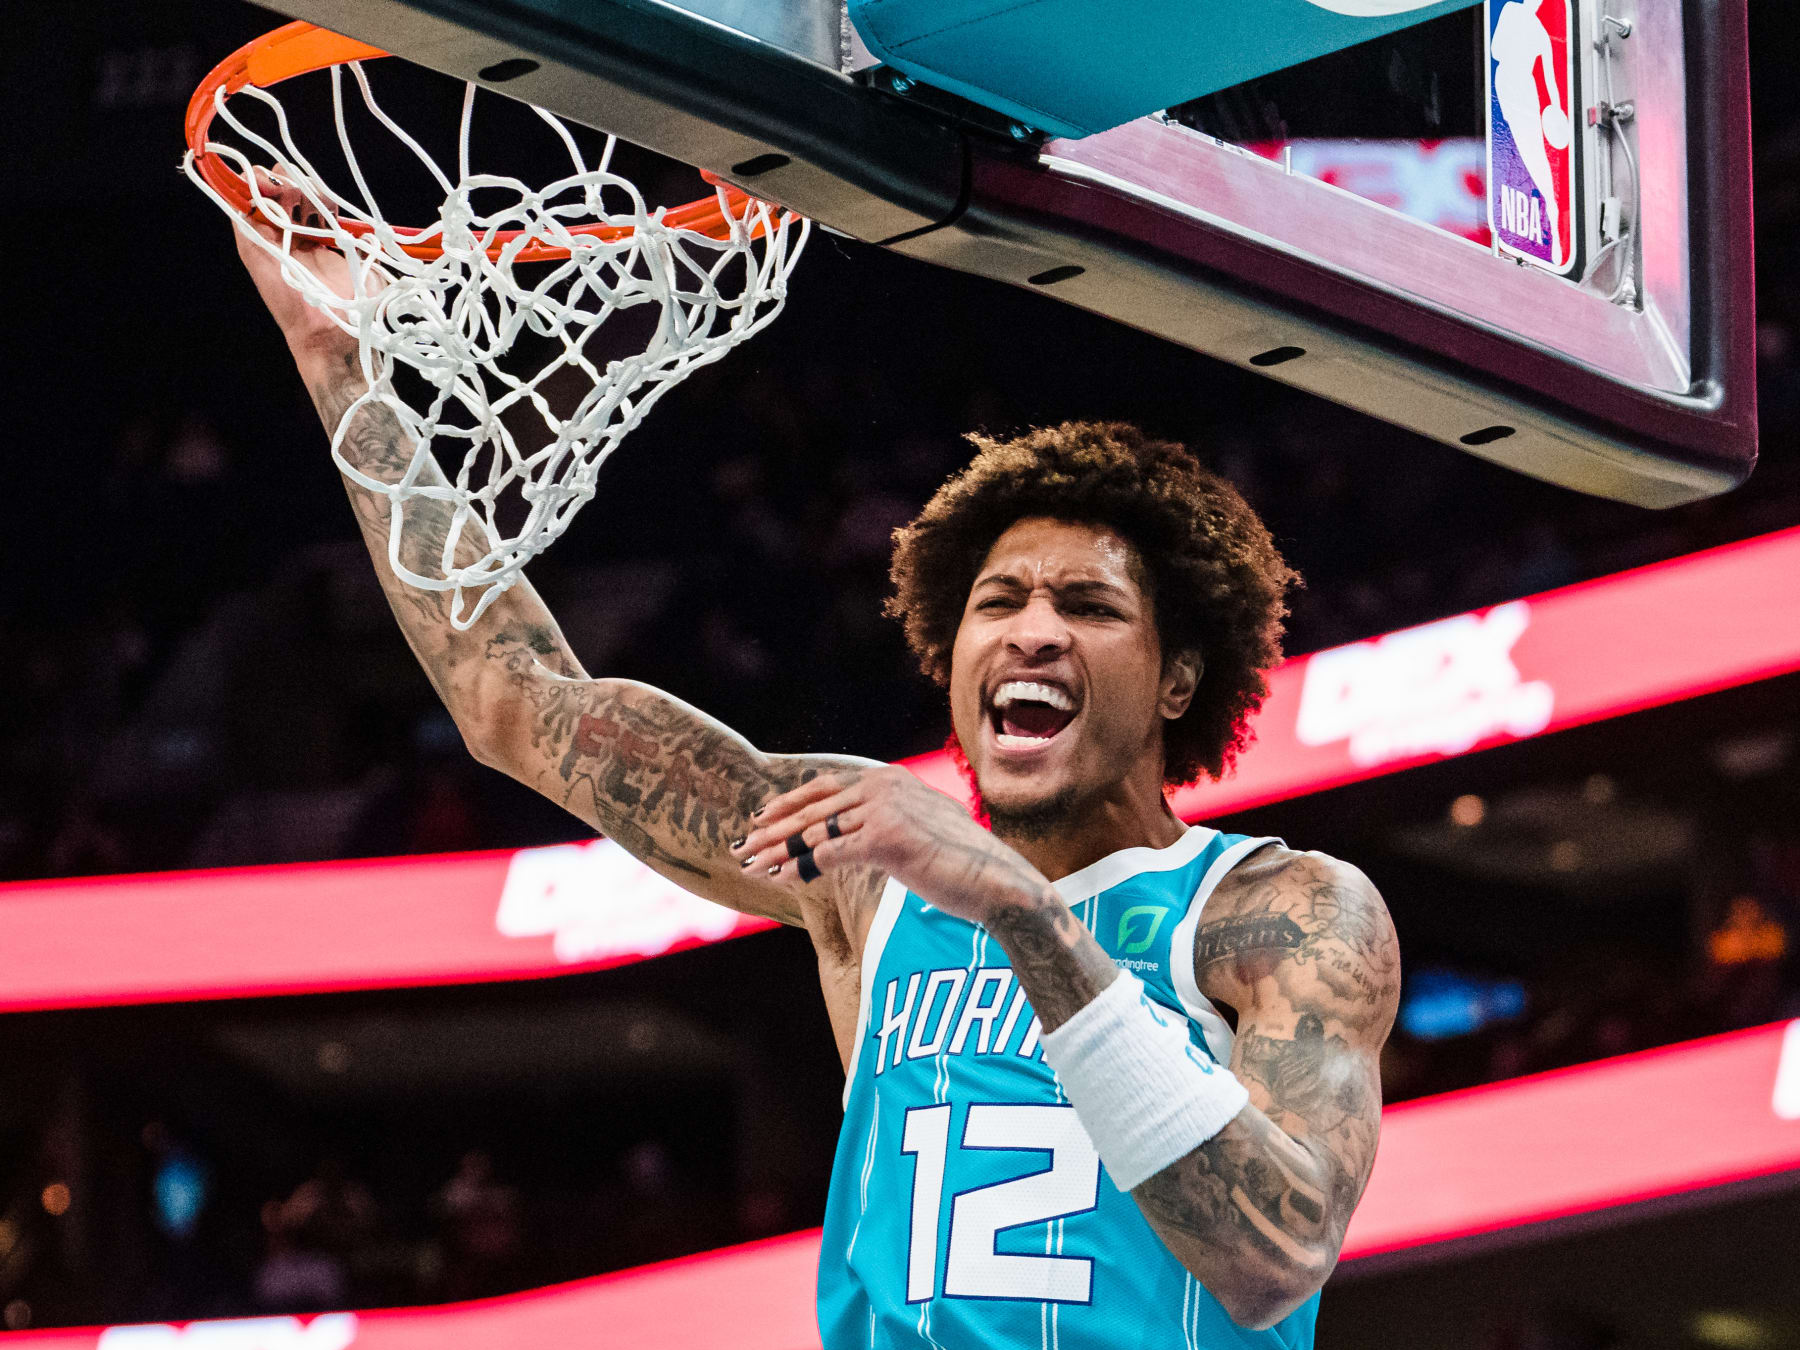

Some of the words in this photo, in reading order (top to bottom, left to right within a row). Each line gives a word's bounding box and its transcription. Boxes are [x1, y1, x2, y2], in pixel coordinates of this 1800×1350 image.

[1501, 184, 1543, 246] NBA
[873, 966, 1050, 1079] HORN
[900, 1101, 1103, 1307] 12
